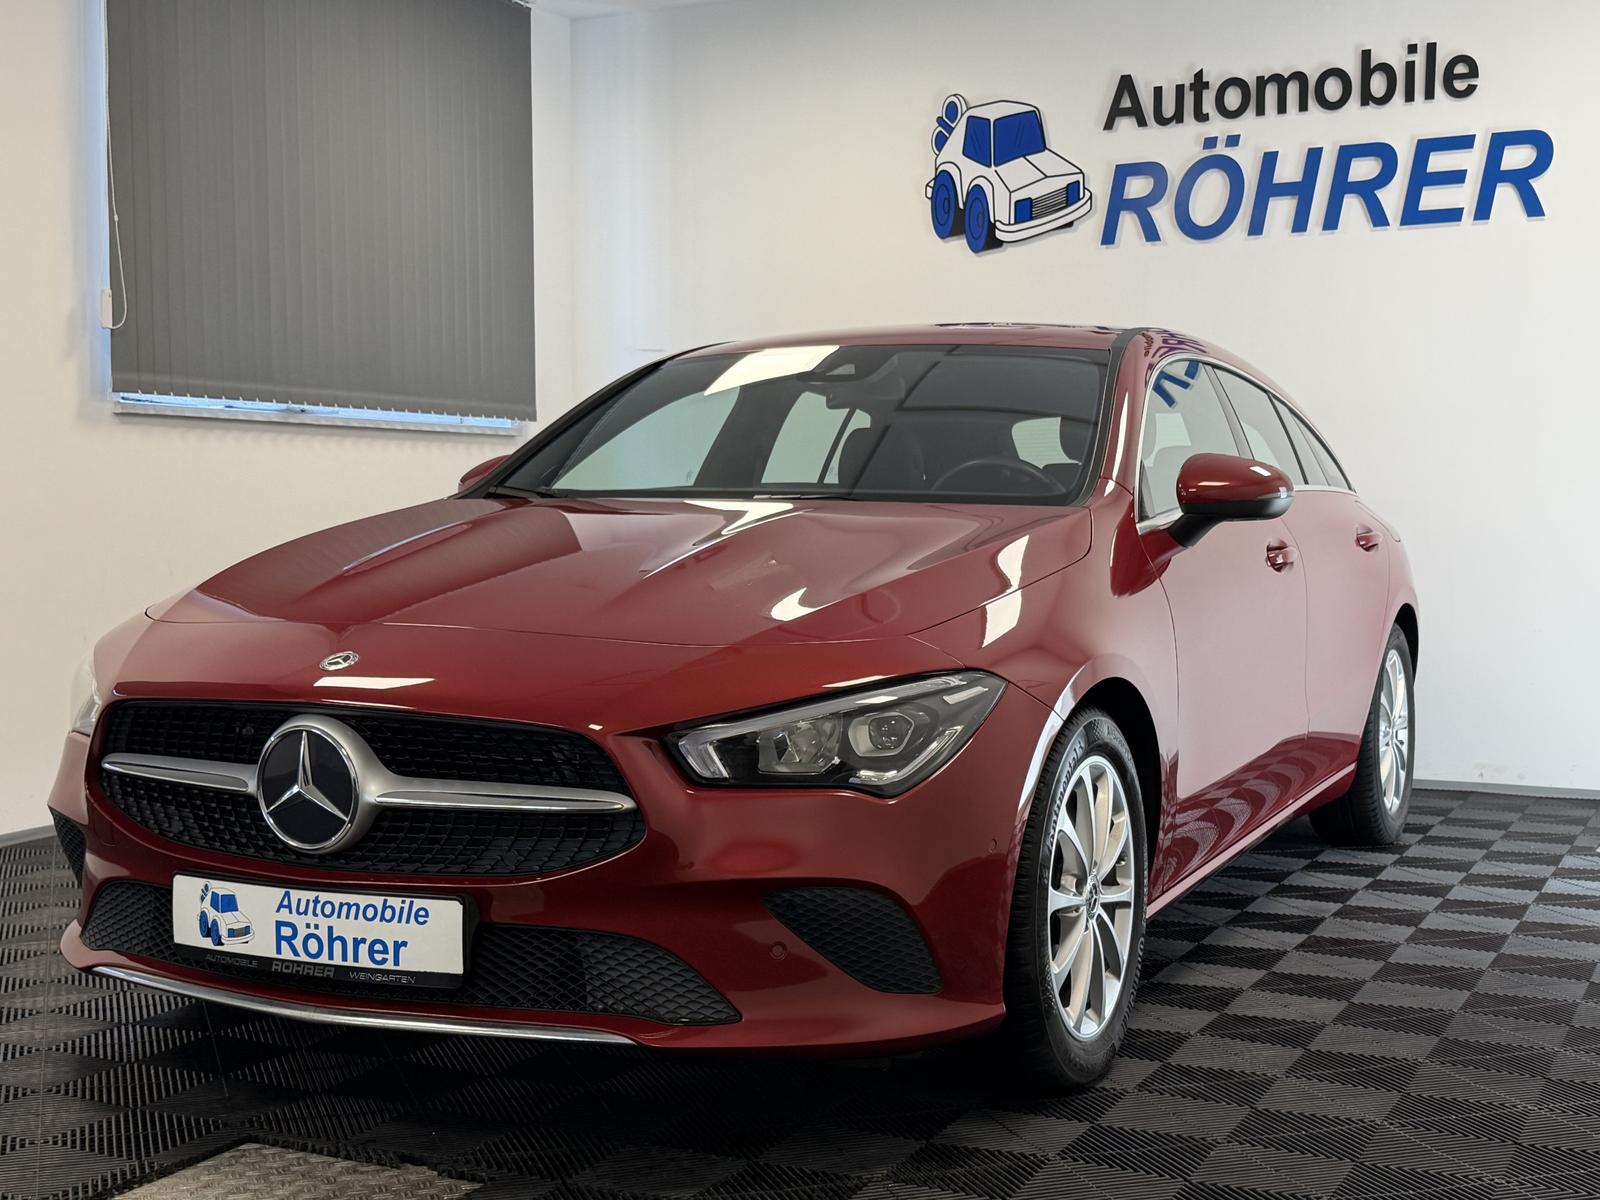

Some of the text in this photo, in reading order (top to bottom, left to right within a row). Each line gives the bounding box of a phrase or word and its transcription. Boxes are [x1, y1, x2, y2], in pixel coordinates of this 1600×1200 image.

[1103, 42, 1479, 130] Automobile
[1100, 129, 1554, 247] RÖHRER
[276, 890, 430, 926] Automobile
[275, 920, 409, 967] Röhrer
[205, 953, 258, 968] AUTOMOBILE
[349, 971, 416, 984] WEINGARTEN
